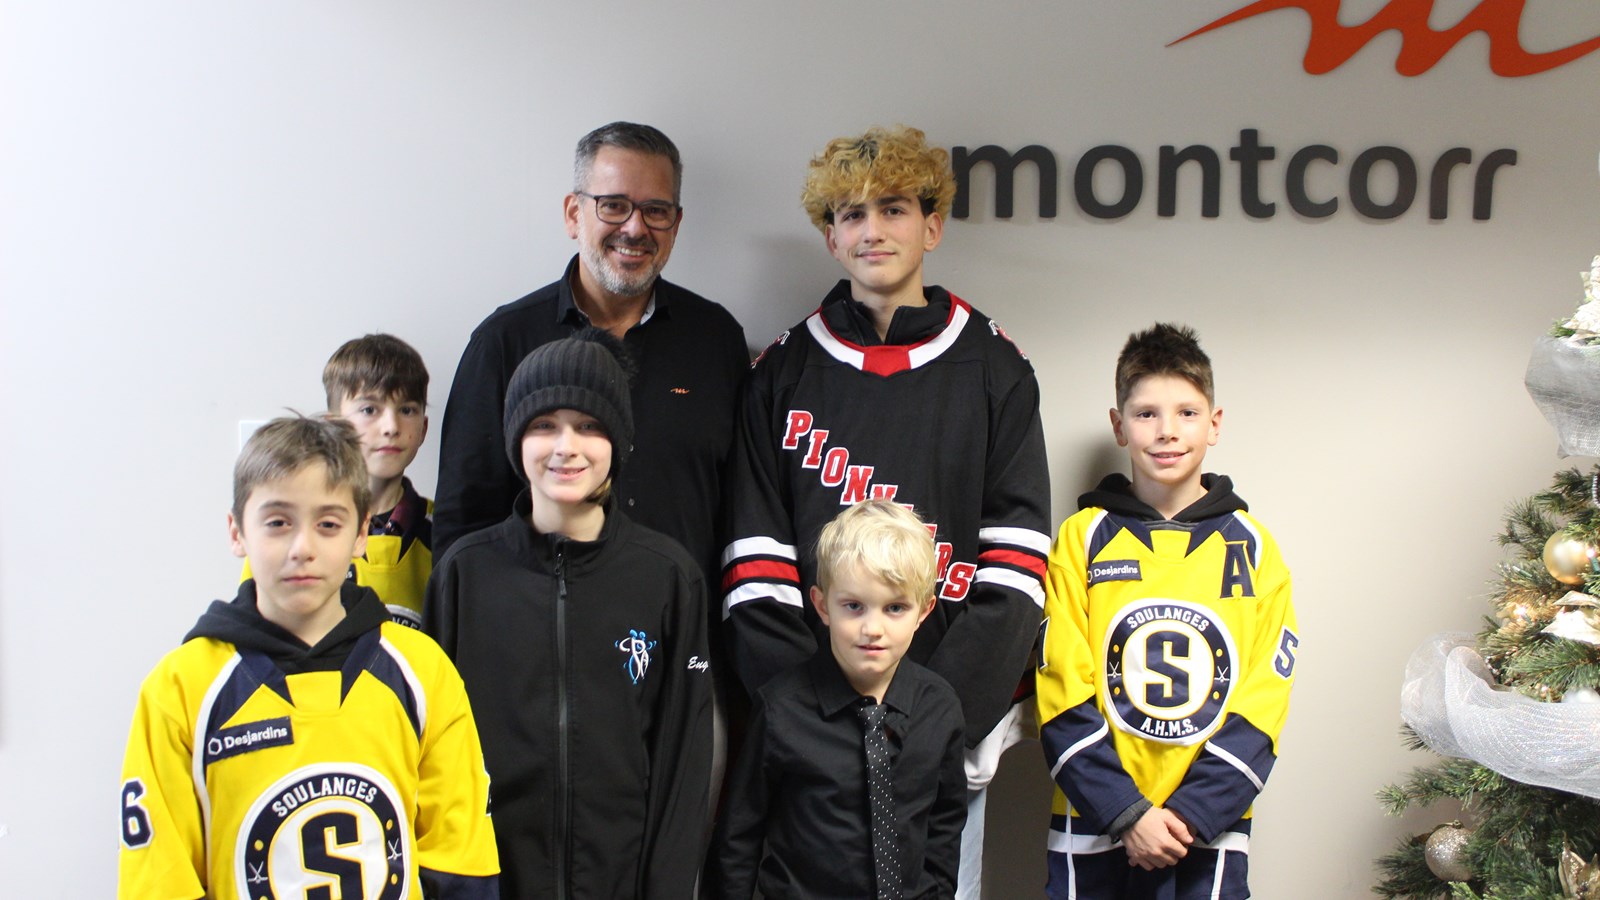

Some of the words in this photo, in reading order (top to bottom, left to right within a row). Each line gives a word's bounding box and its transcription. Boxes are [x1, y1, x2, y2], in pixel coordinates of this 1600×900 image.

[951, 128, 1517, 220] montcorr
[1093, 564, 1139, 578] Desjardins
[1219, 540, 1256, 599] A
[1126, 607, 1210, 633] SOULANGES
[1143, 629, 1191, 709] S
[1273, 626, 1299, 680] 5
[224, 726, 288, 750] Desjardins
[1140, 718, 1199, 736] A.H.M.S.
[120, 777, 154, 850] 6
[271, 776, 378, 818] SOULANGES
[298, 809, 366, 900] S
